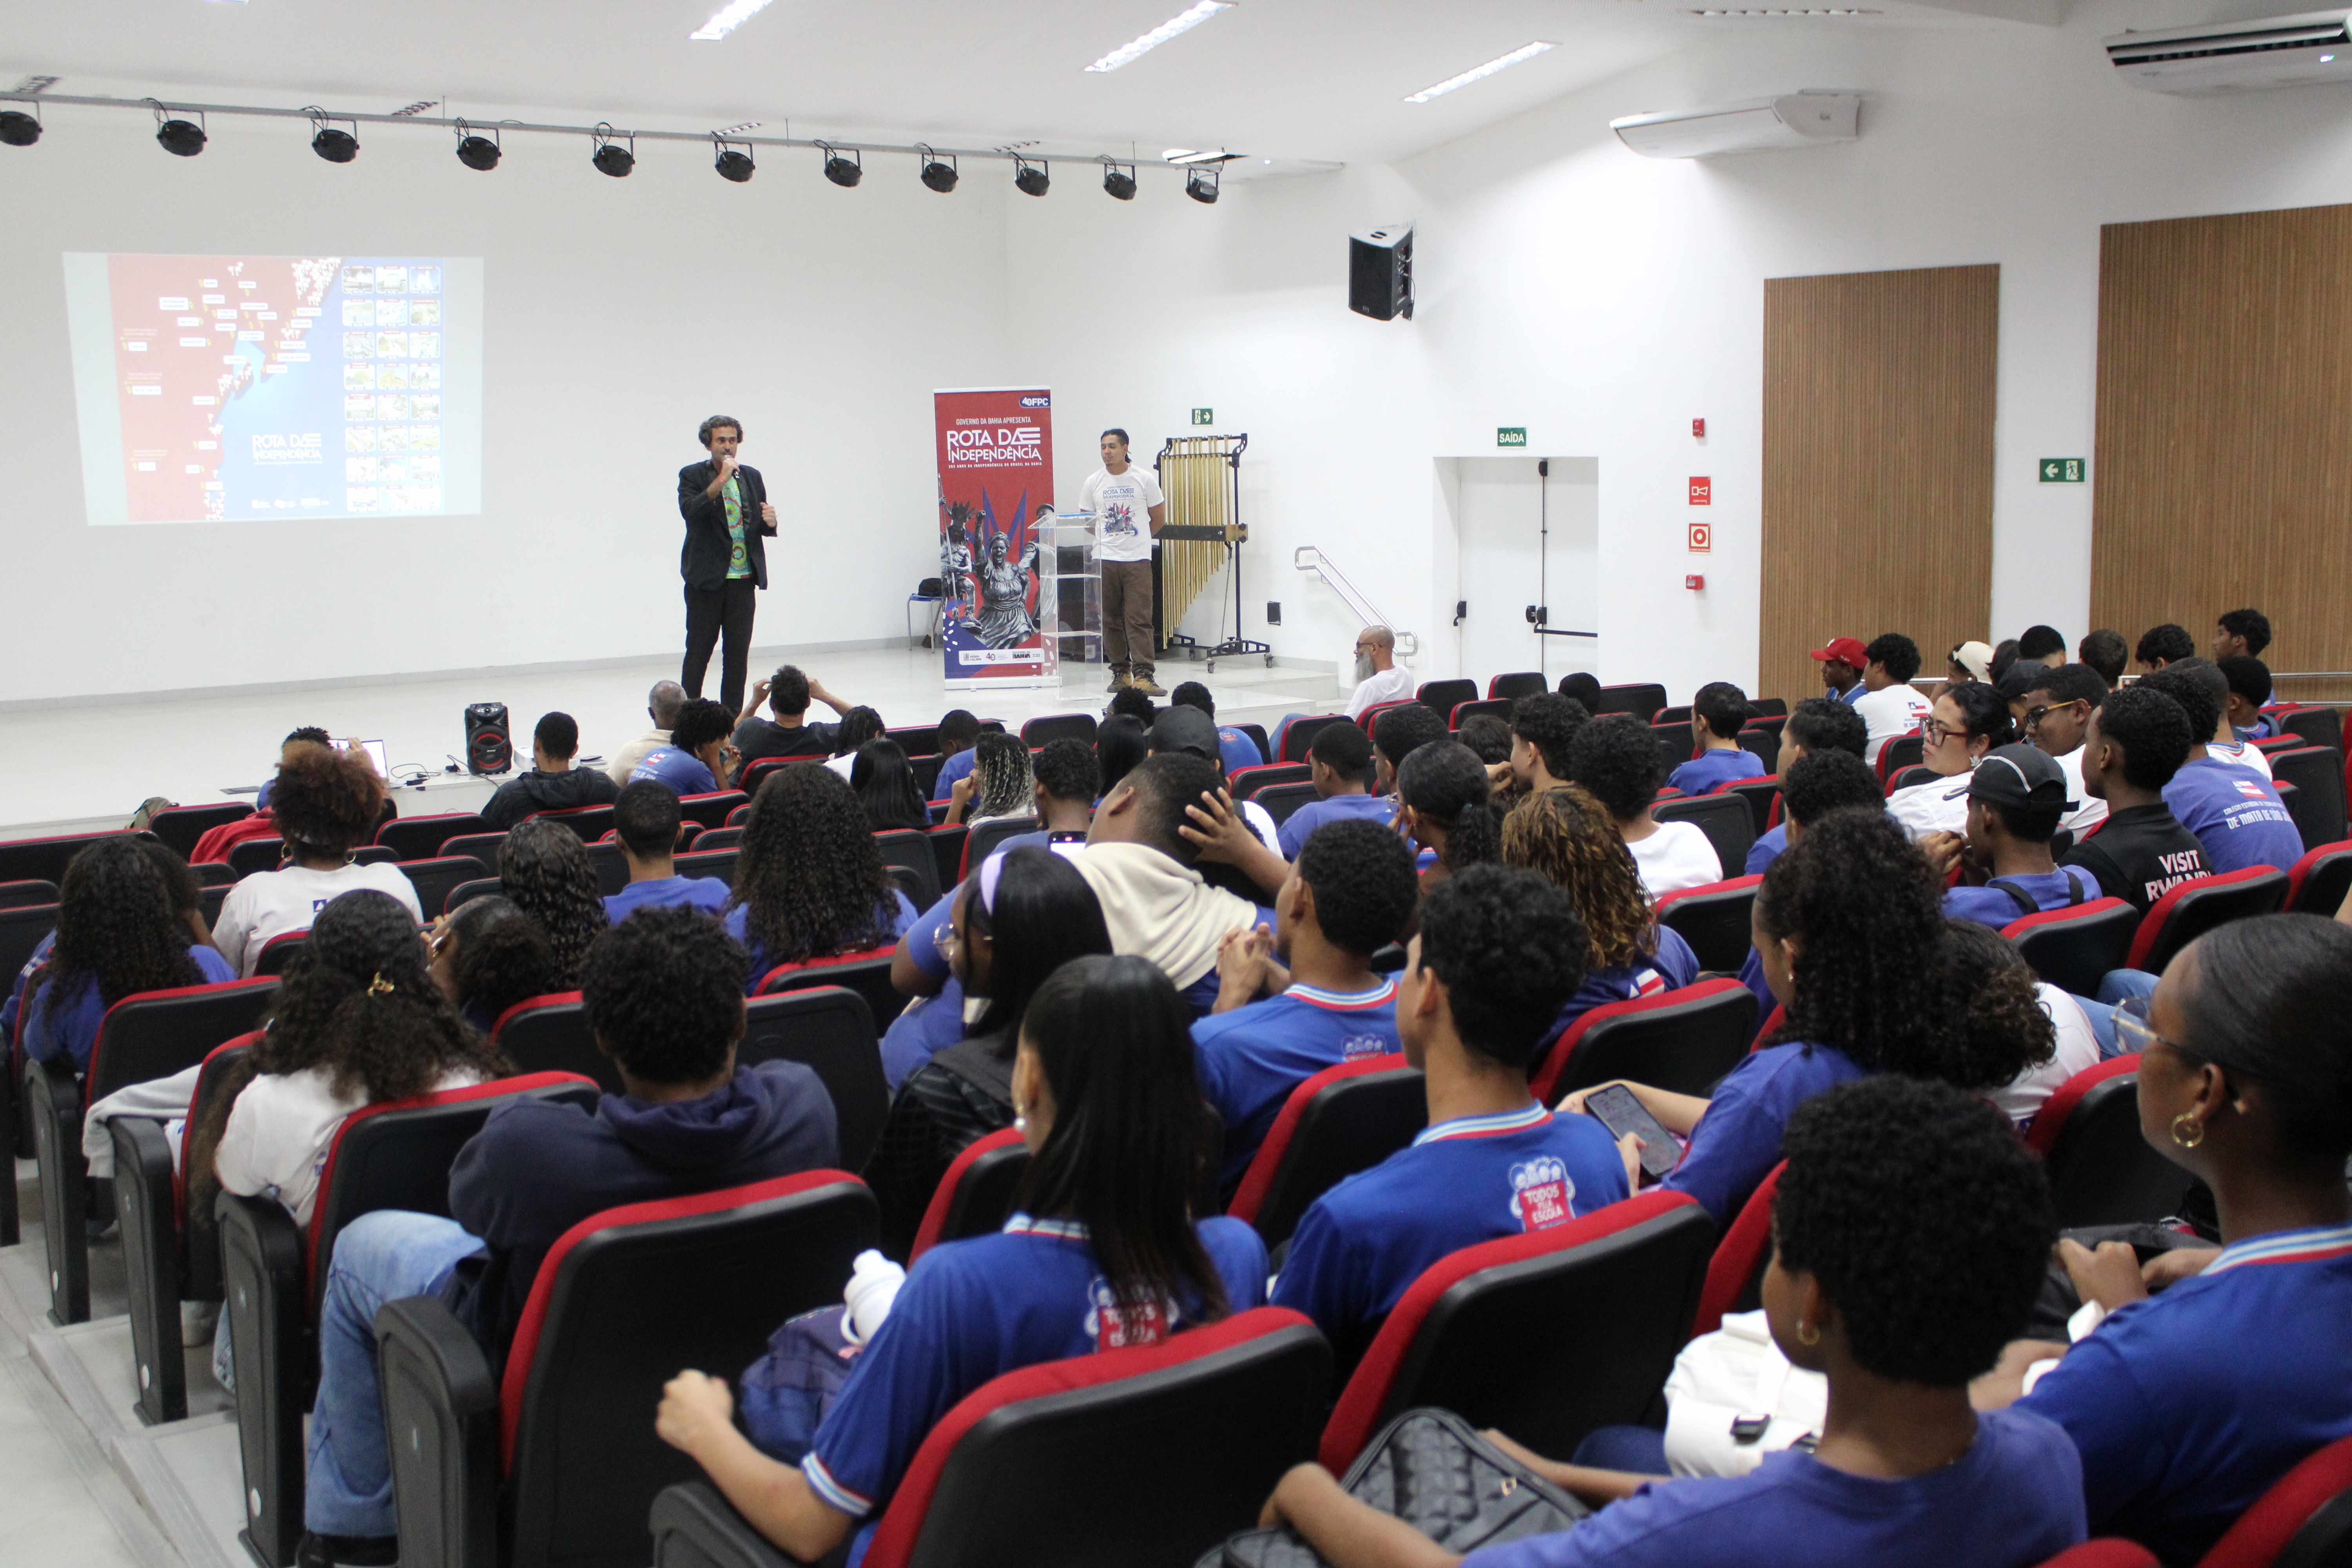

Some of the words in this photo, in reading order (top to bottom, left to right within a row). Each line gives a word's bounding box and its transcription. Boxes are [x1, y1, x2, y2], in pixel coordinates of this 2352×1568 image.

[252, 434, 287, 448] ROTA
[947, 430, 993, 447] ROTA
[1499, 432, 1524, 443] SAÍDA
[948, 445, 1042, 463] INDEPENDÊNCIA
[2226, 817, 2240, 830] DE
[2238, 810, 2264, 826] MATA
[2158, 849, 2201, 874] VISIT
[1524, 1183, 1559, 1205] TODOS
[1532, 1205, 1564, 1223] ESCOLA
